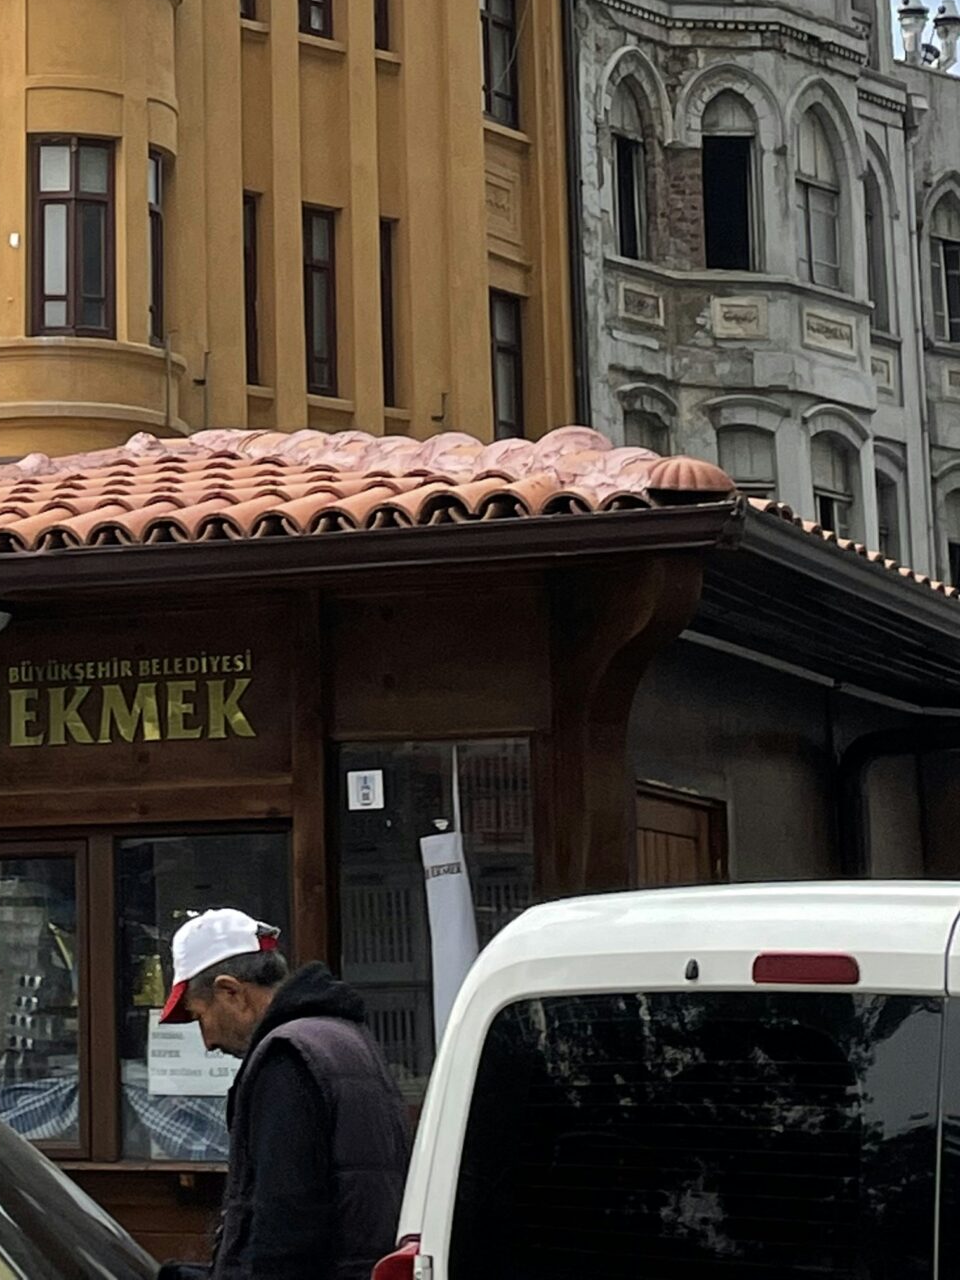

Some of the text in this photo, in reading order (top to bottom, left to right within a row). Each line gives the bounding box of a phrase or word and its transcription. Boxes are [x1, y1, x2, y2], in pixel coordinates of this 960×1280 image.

[8, 657, 134, 684] BÜYÜKŞEHİR
[139, 649, 252, 676] BELEDİYESİ
[9, 677, 257, 747] EKMEK
